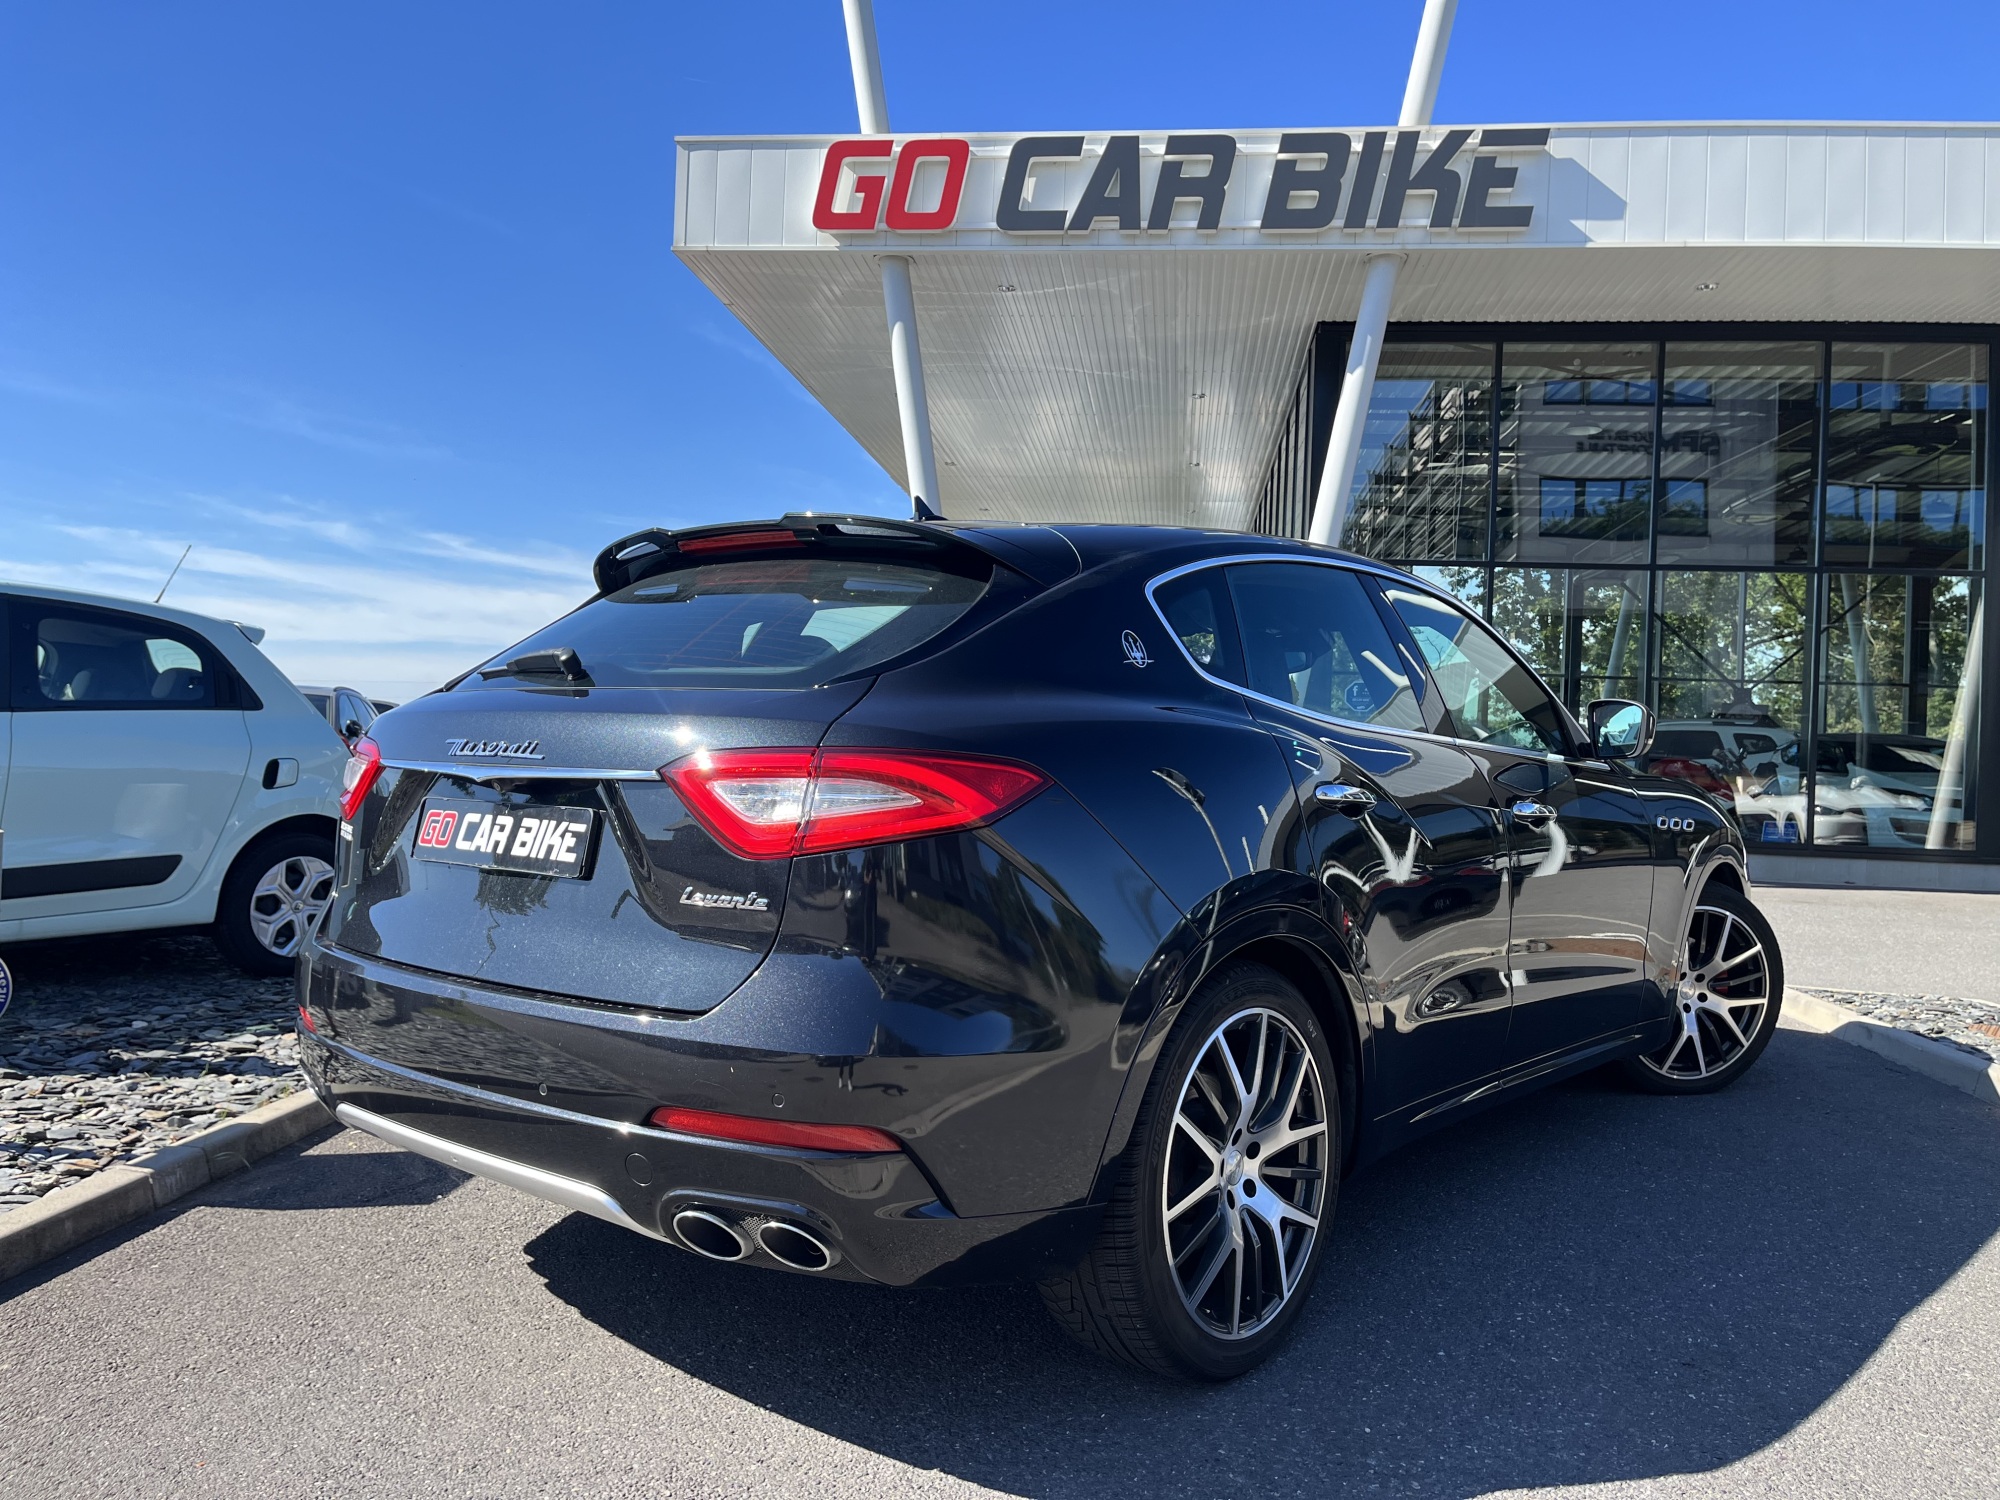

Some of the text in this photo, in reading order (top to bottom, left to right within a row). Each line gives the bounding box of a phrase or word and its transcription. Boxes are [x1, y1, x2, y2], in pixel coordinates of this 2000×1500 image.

[811, 128, 1551, 235] GO CAR BIKE
[445, 739, 545, 760] Maserati
[418, 809, 587, 863] GO CAR BIKE
[679, 886, 769, 911] Levante
